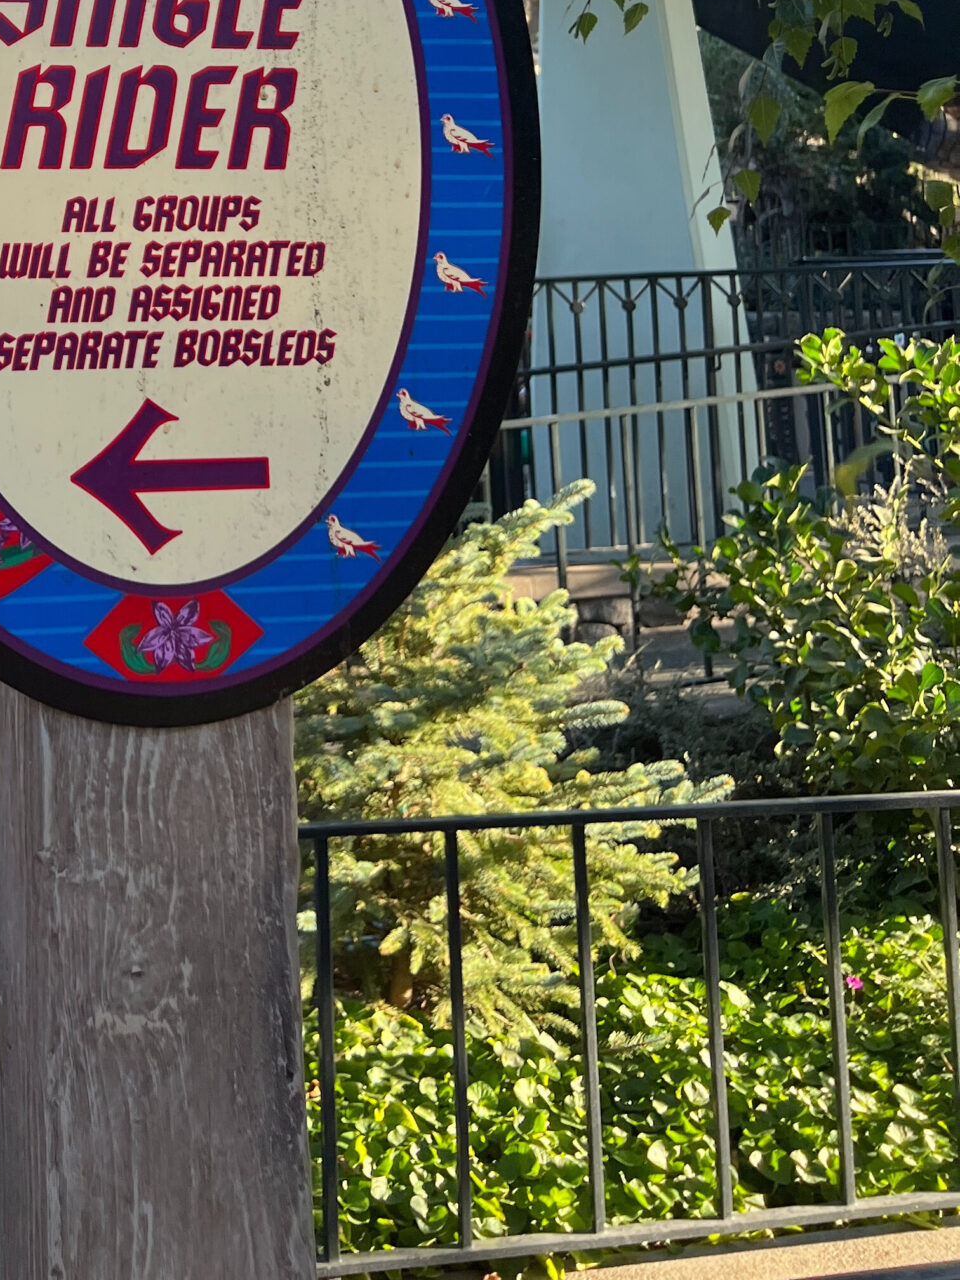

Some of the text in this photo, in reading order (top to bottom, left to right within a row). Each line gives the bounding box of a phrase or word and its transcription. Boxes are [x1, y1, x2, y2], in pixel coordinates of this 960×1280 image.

[0, 64, 298, 170] RIDER
[61, 195, 262, 232] ALL GROUPS
[86, 241, 132, 278] BE
[140, 240, 326, 277] SEPARATED
[46, 284, 281, 323] AND ASSIGNED
[173, 328, 337, 367] BOBSLEDS
